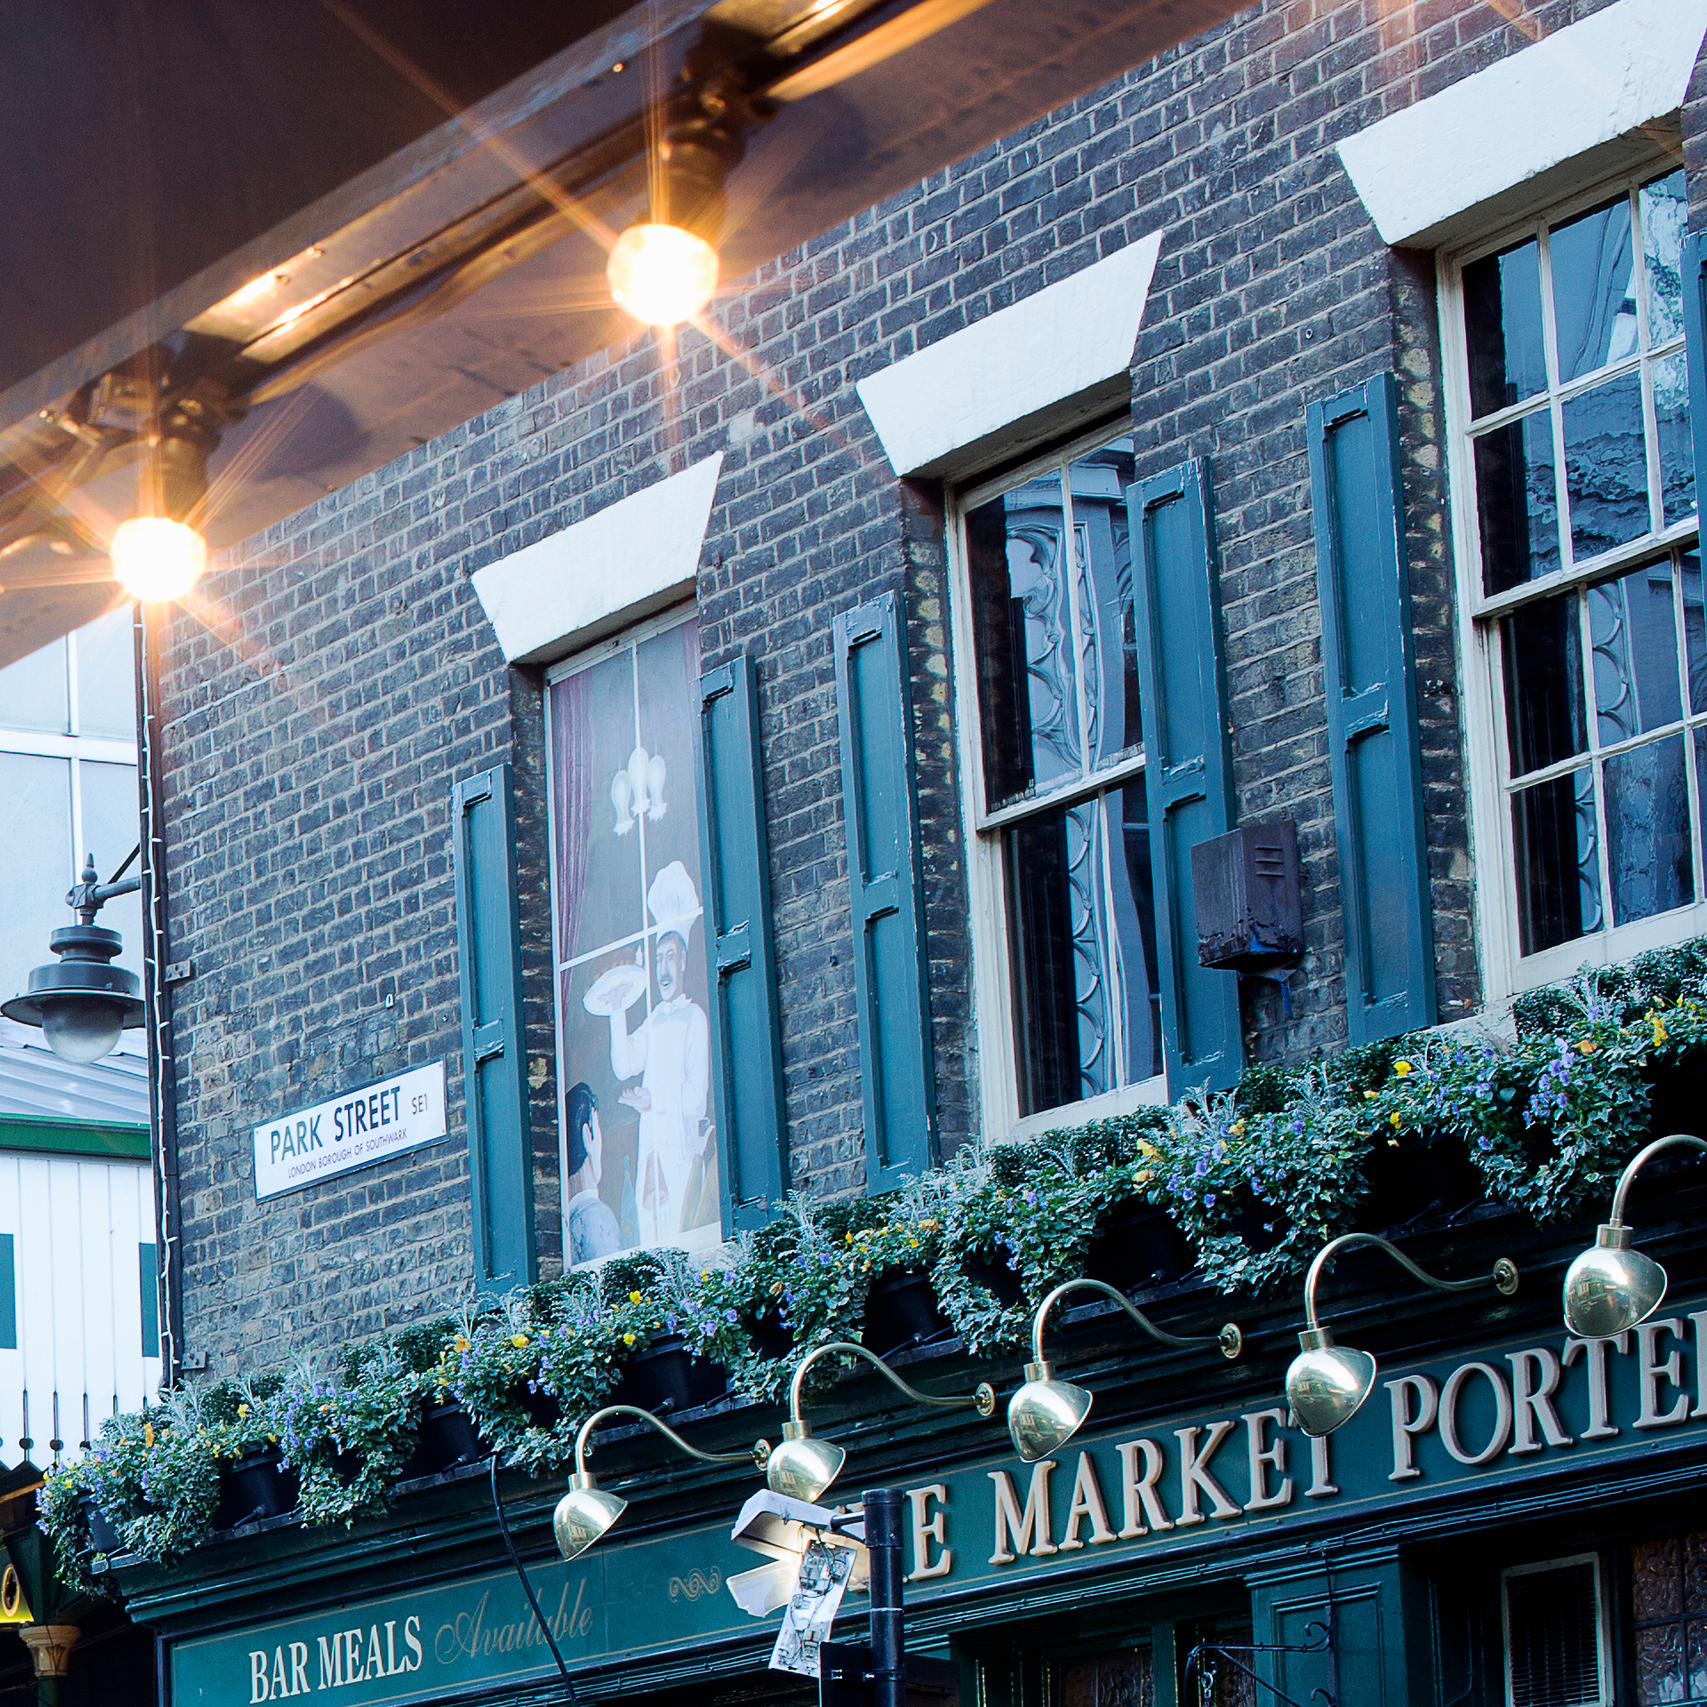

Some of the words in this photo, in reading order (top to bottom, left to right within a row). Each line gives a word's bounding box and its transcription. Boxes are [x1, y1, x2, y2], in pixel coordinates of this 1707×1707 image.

[270, 1114, 323, 1165] PARK
[334, 1086, 401, 1142] STREET
[412, 1093, 428, 1115] SE1
[288, 1160, 316, 1179] LONDON
[319, 1147, 352, 1169] BOROUGH
[354, 1143, 363, 1156] OF
[366, 1128, 408, 1152] SOUTHWARK
[249, 1641, 311, 1704] BAR
[317, 1614, 424, 1690] MEALS
[434, 1577, 595, 1666] Available
